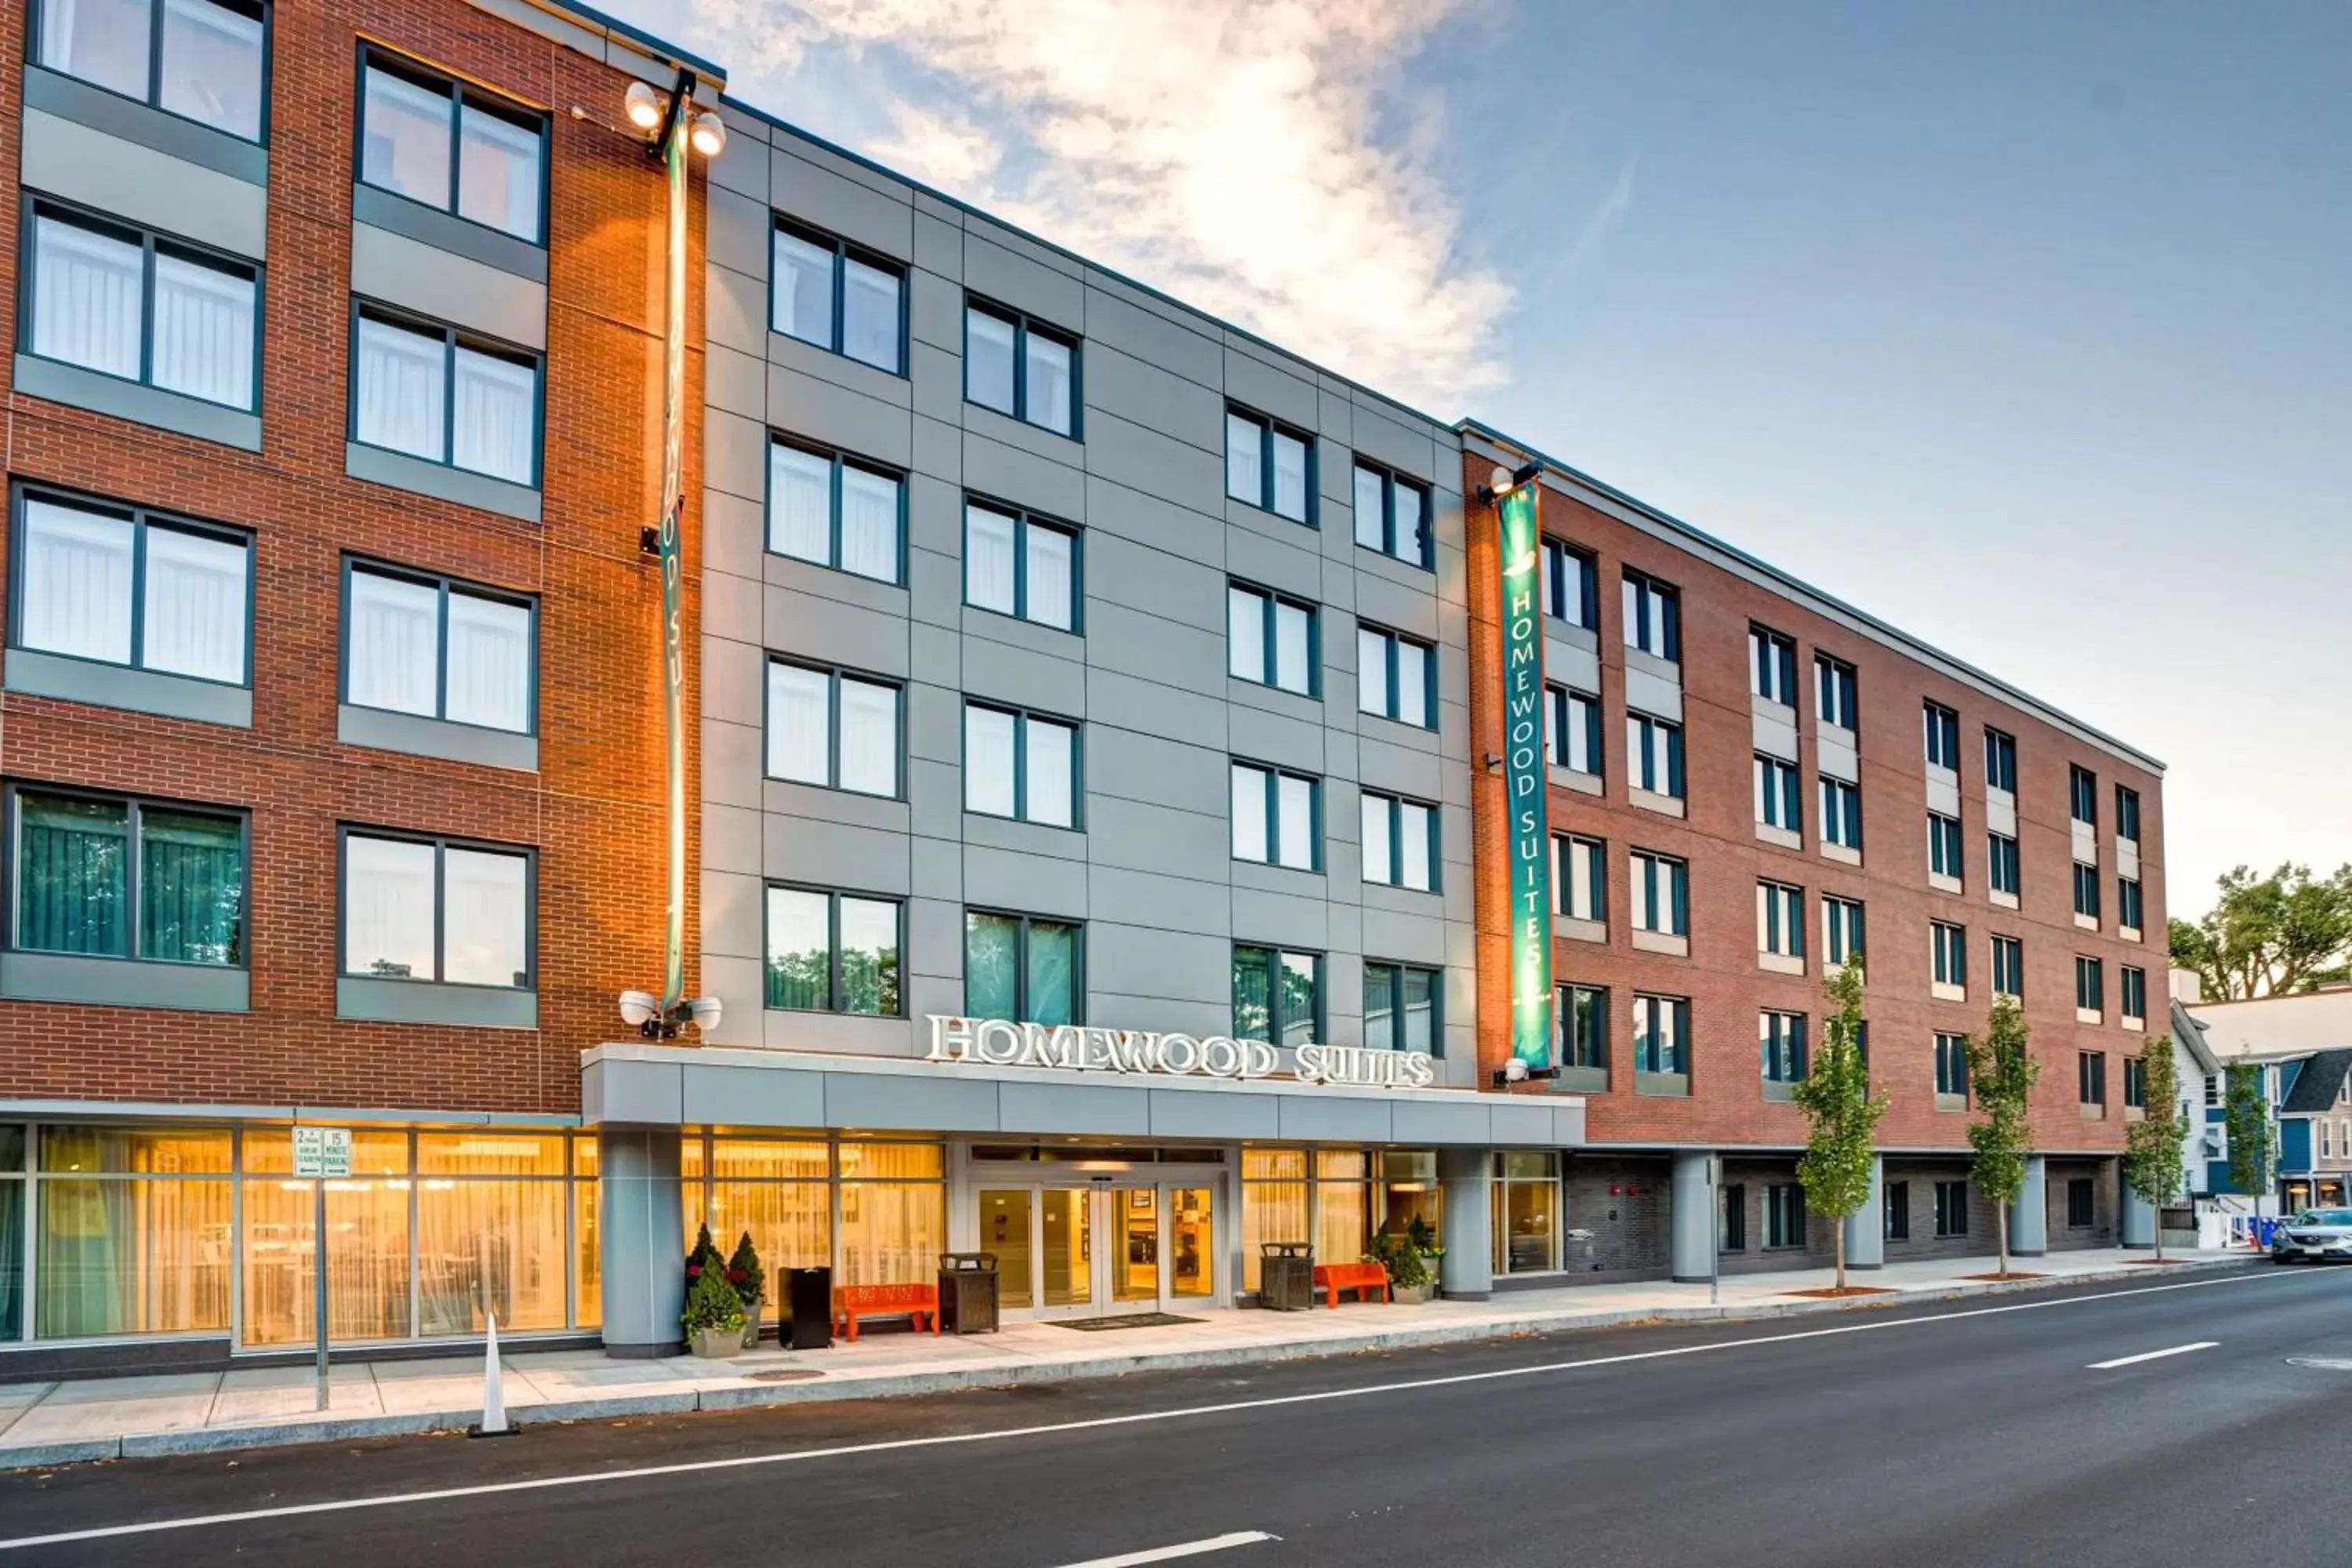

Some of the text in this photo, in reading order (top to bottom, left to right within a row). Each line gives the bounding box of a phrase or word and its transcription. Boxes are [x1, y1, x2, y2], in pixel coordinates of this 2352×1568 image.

[1511, 591, 1541, 964] HOMEWOOD SUITES
[925, 1014, 1434, 1088] HOMEWOOD SUITES
